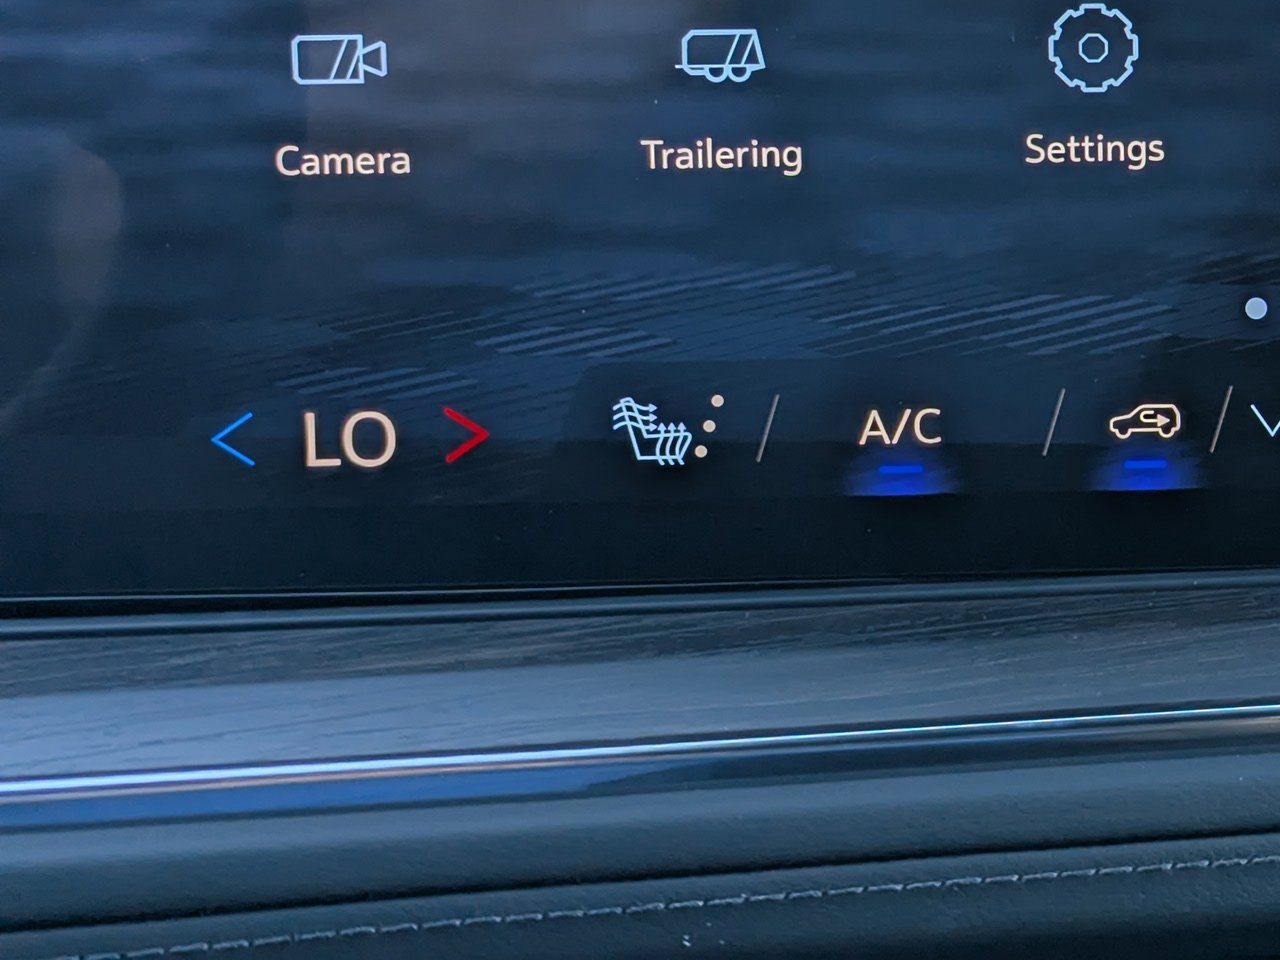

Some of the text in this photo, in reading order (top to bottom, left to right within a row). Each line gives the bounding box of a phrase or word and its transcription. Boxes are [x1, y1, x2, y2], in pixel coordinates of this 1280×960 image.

[275, 145, 411, 176] Camera
[640, 137, 802, 177] Trailering
[1025, 133, 1165, 171] Settings
[304, 410, 396, 468] LO
[858, 408, 942, 446] A/C
